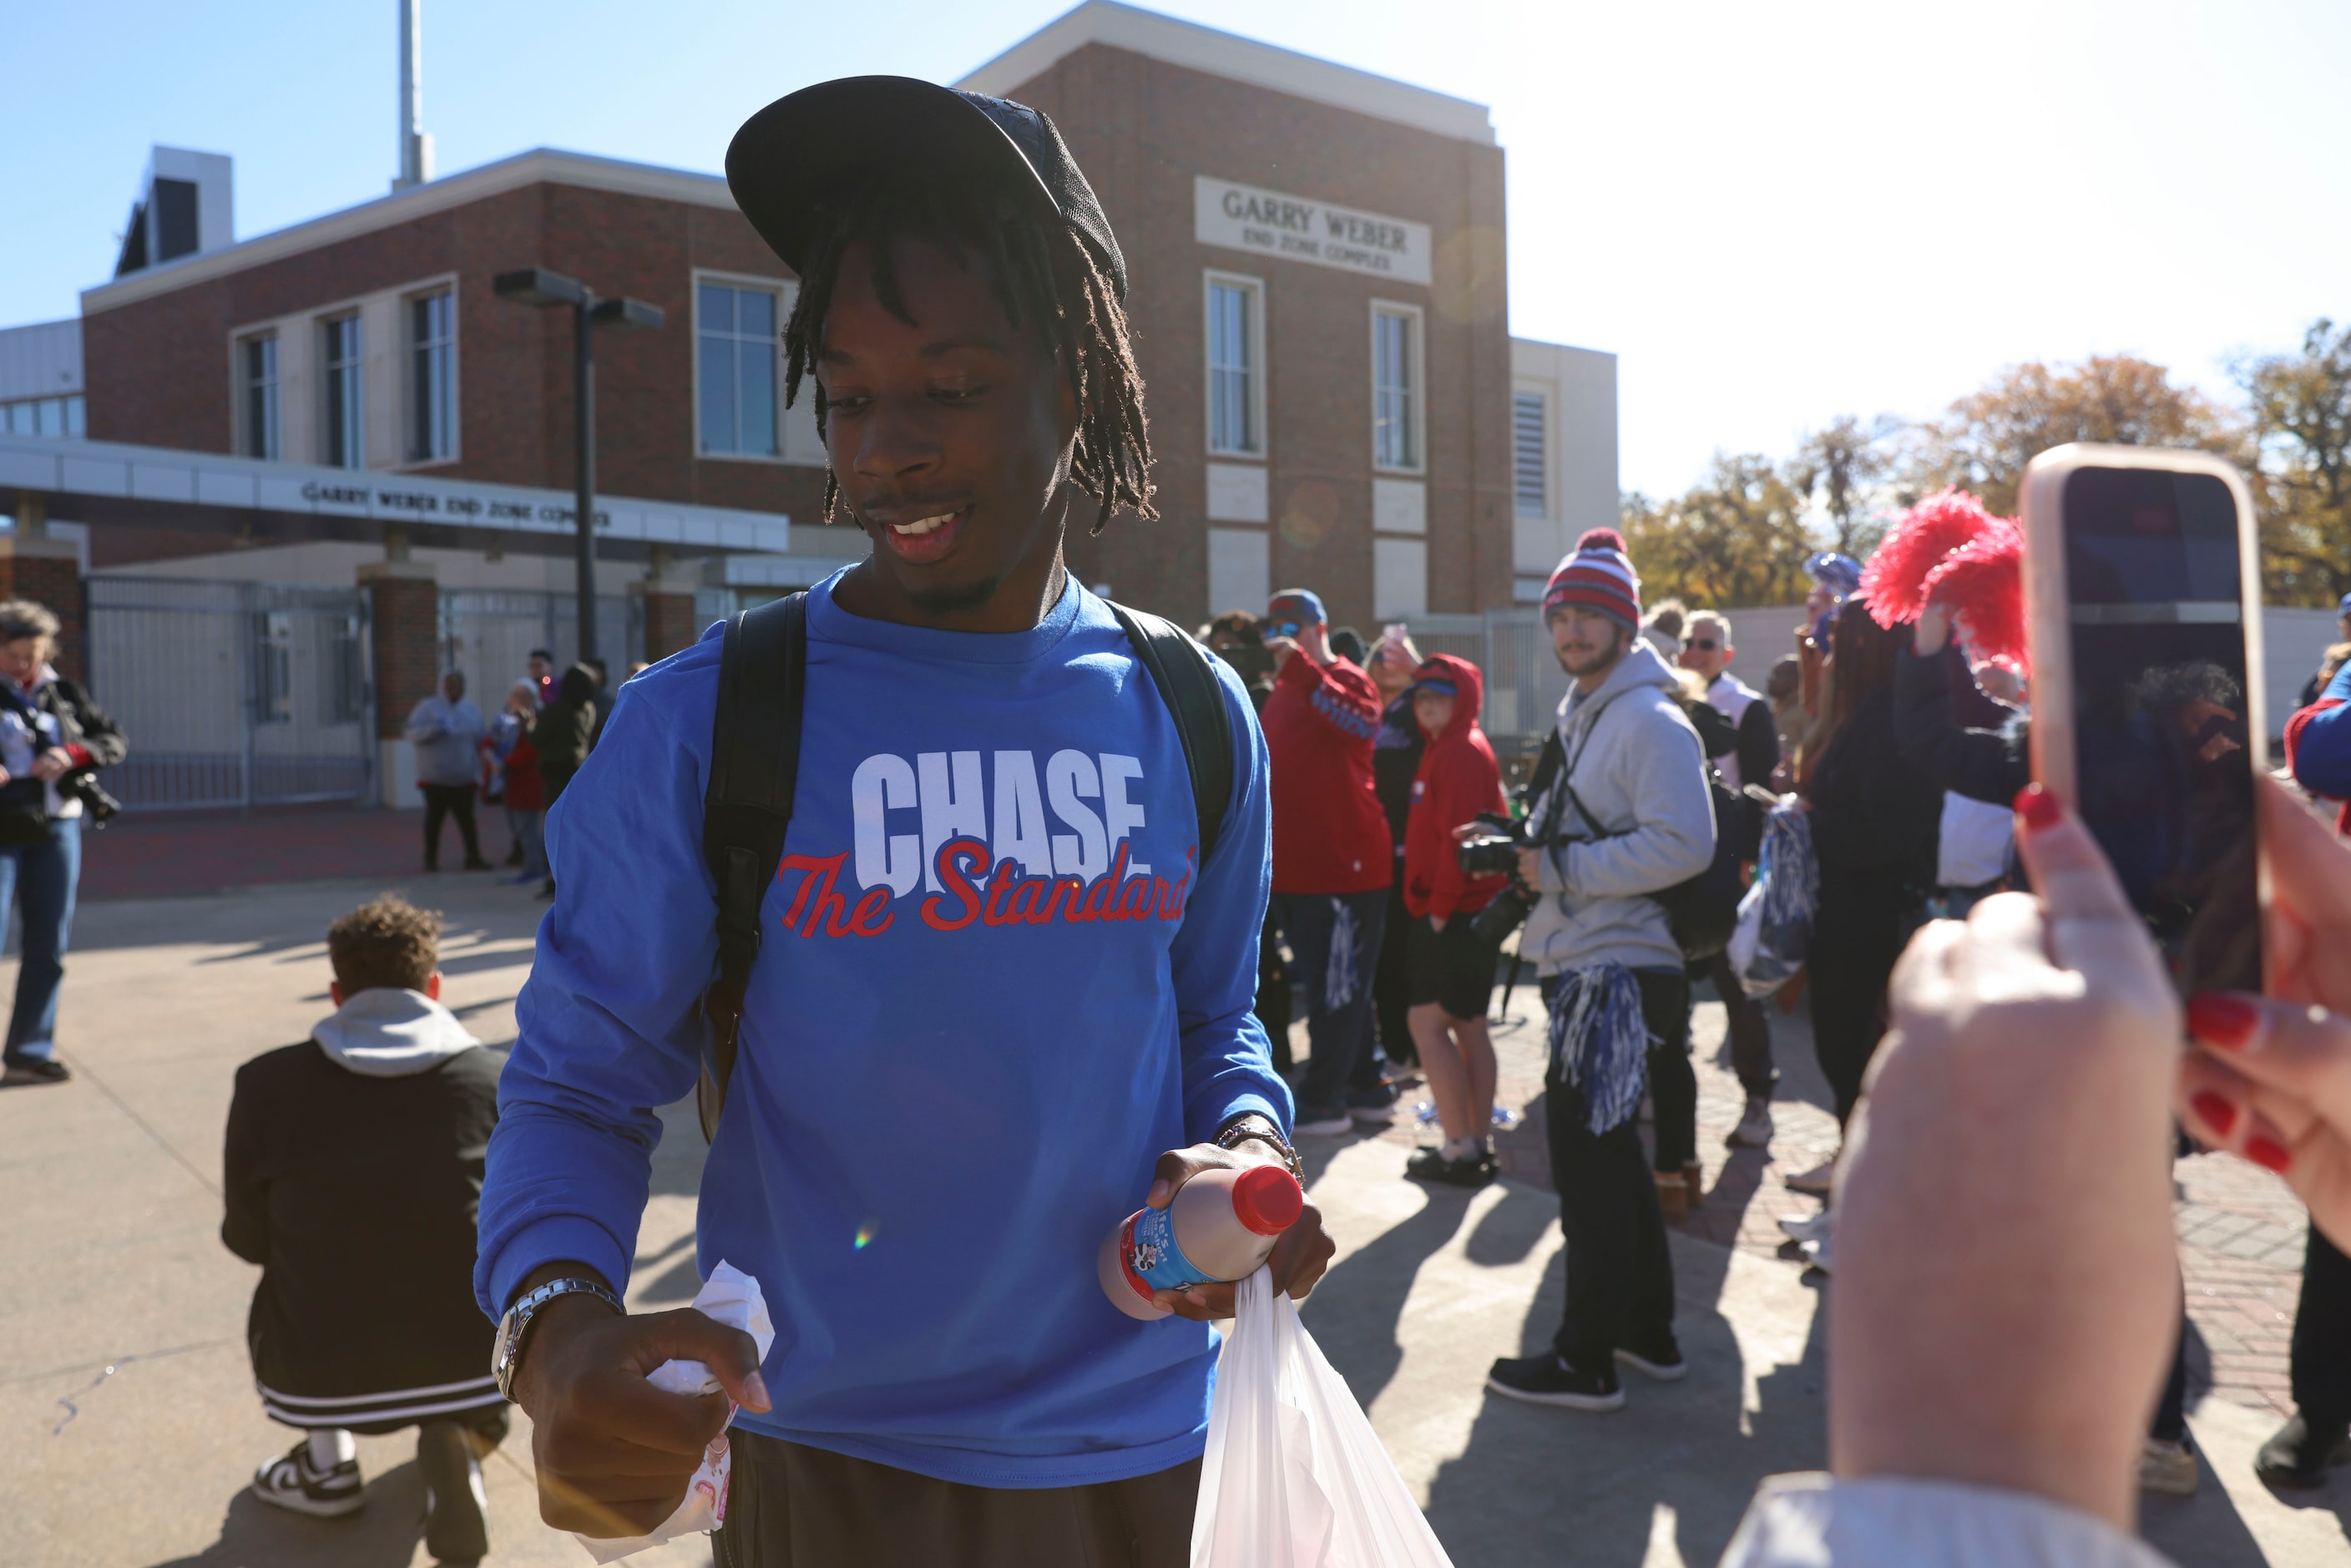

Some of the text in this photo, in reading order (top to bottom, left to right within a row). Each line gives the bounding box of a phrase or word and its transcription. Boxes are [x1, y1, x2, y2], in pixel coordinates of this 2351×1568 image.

[1222, 190, 1409, 255] GARRY WEBER
[1242, 227, 1276, 248] END
[1280, 235, 1320, 257] ZONE
[301, 481, 369, 504] GARRY
[378, 489, 439, 512] WEBER
[446, 495, 483, 516] END
[489, 499, 533, 522] ZONE
[852, 749, 1151, 898] CHASE
[779, 841, 1196, 938] The Standard
